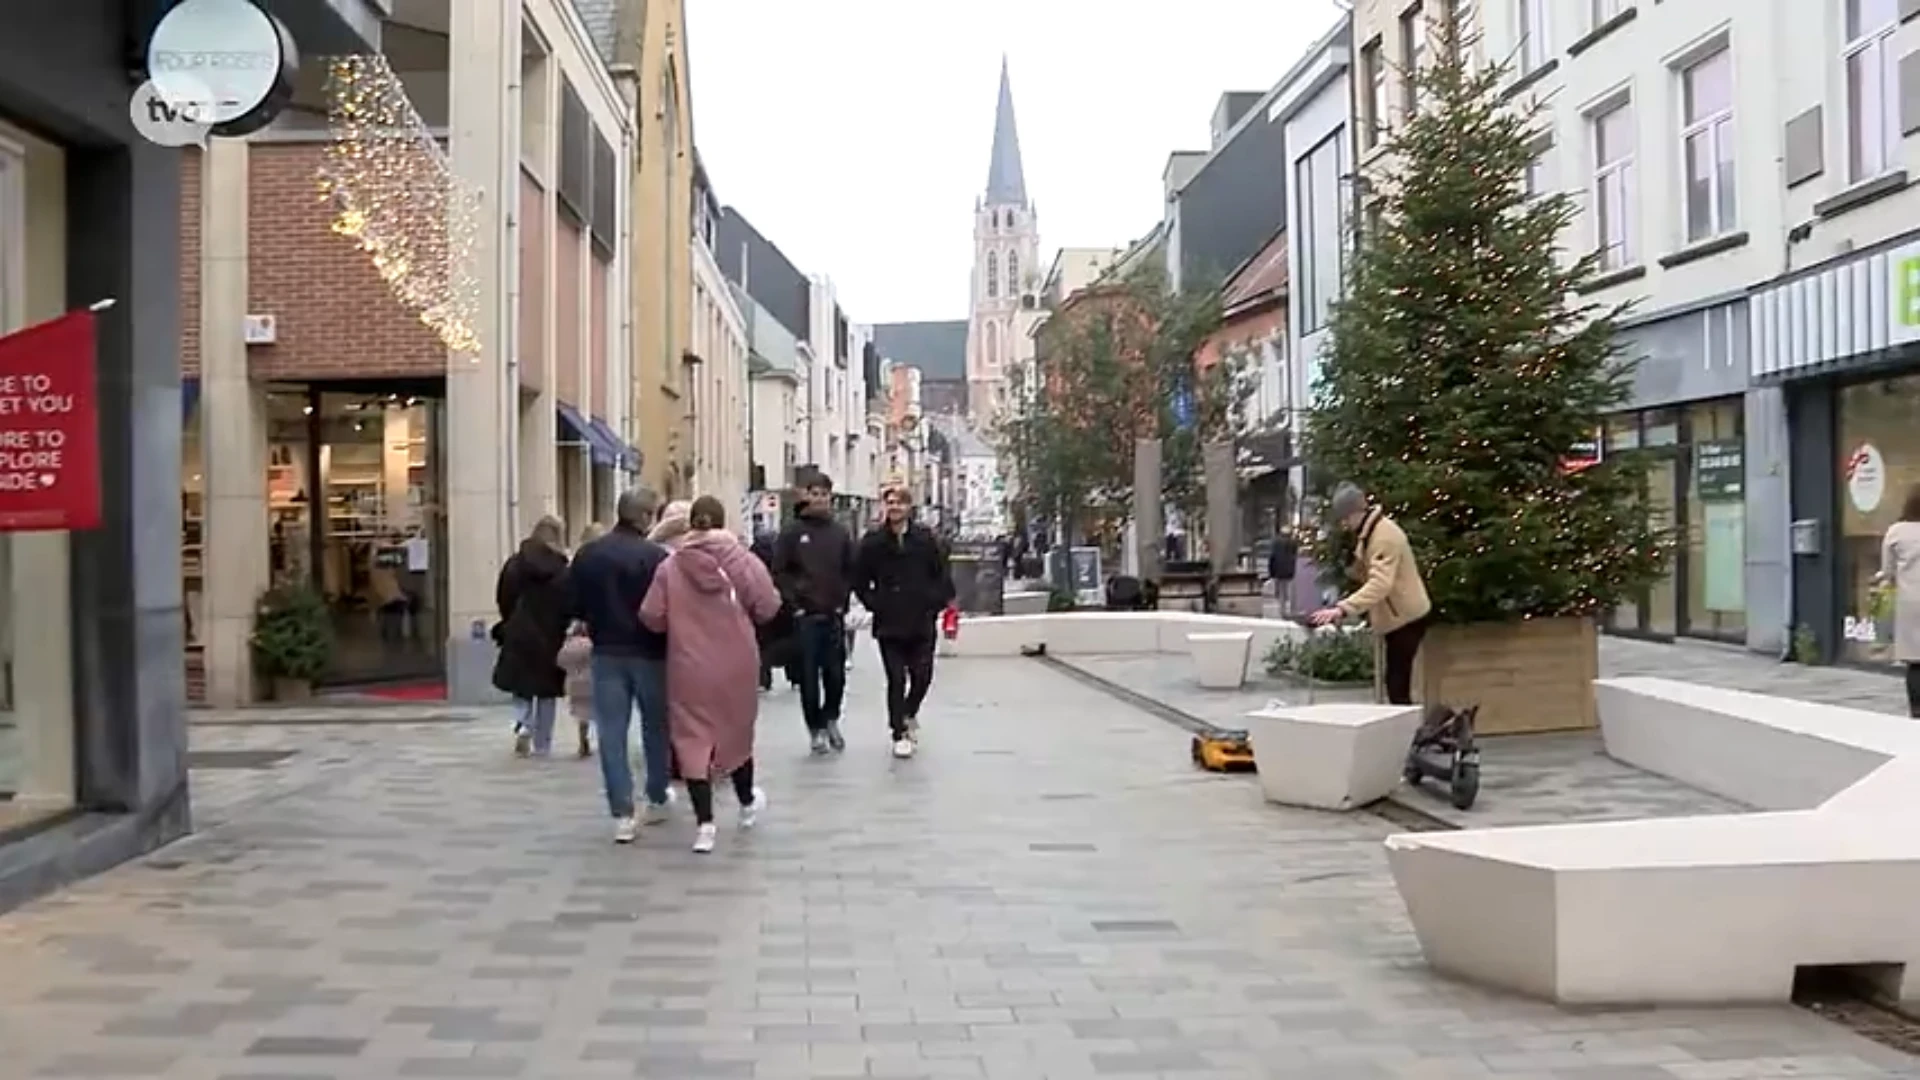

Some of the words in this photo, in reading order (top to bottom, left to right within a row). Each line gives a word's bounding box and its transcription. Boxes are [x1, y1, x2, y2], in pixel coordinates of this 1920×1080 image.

[21, 374, 51, 393] TO
[28, 393, 74, 413] YOU
[35, 429, 66, 448] TO
